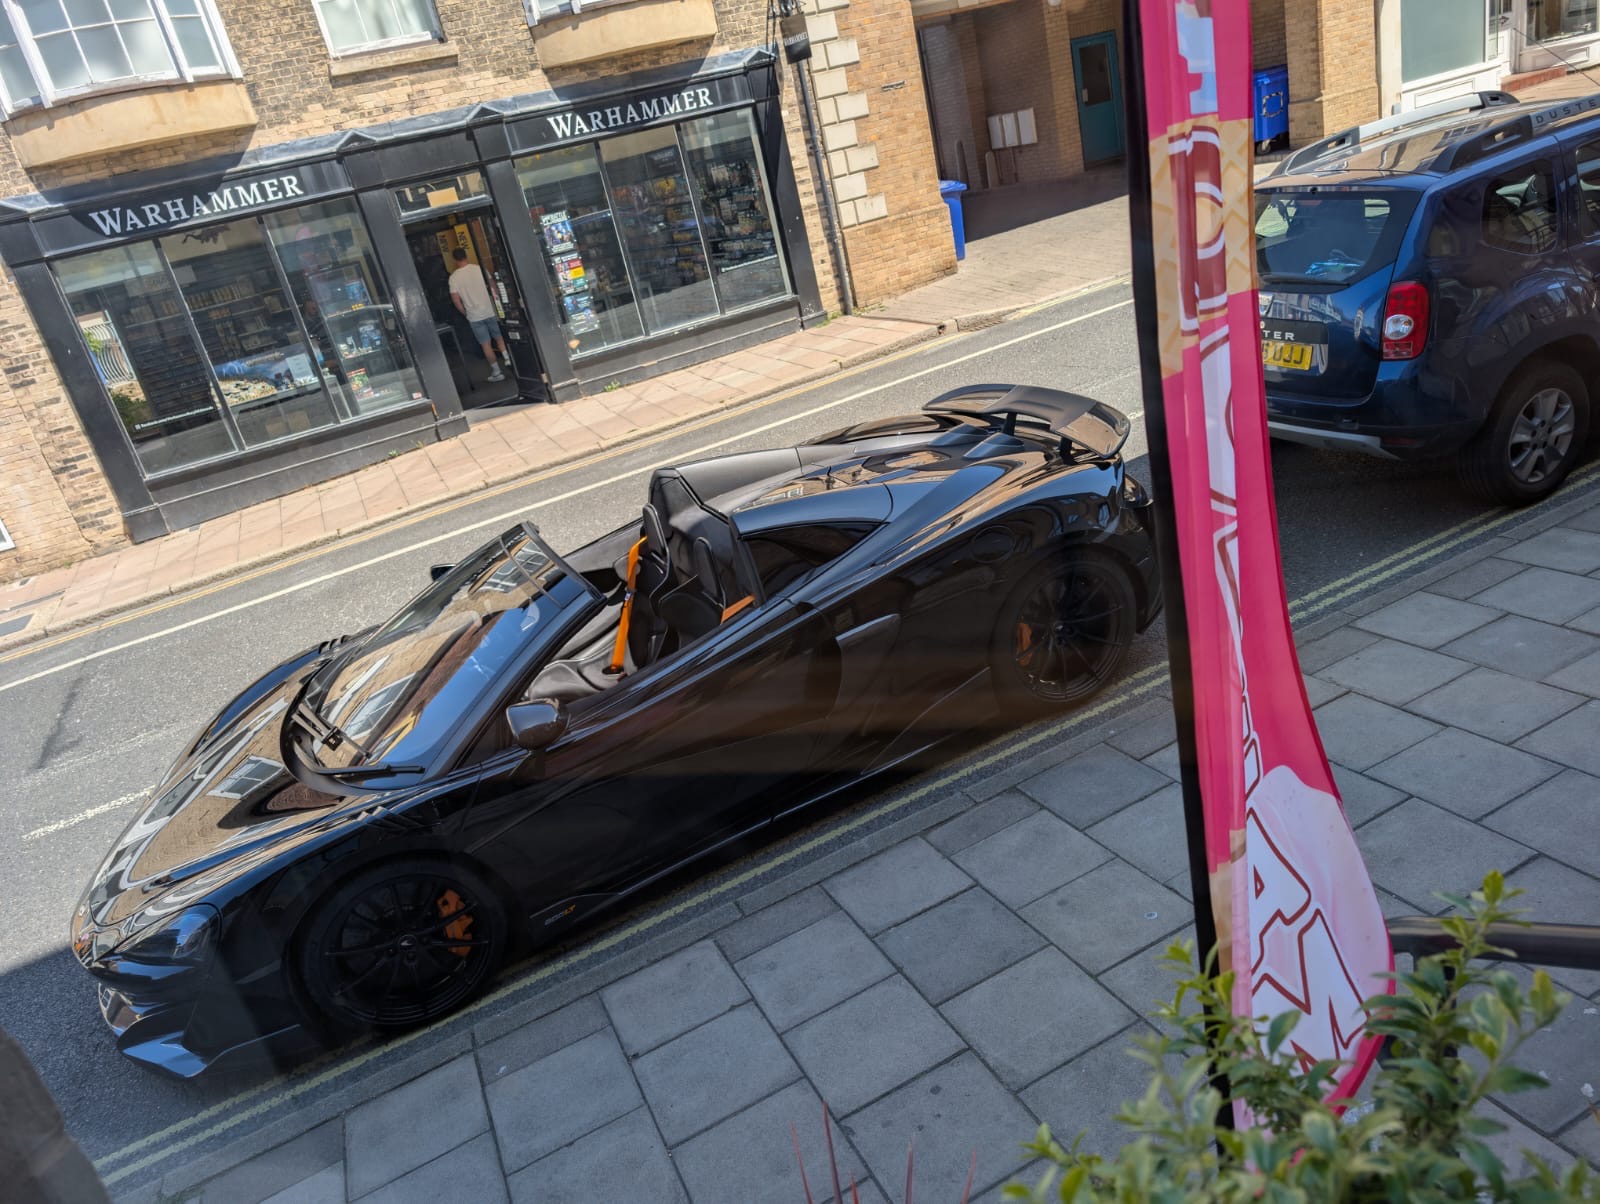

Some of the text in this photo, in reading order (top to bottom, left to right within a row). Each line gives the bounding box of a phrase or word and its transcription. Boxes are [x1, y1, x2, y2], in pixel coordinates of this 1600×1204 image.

[547, 87, 713, 139] WARHAMMER
[1535, 98, 1597, 124] DUSTE
[88, 175, 304, 236] WARHAMMER
[1263, 330, 1295, 341] TER
